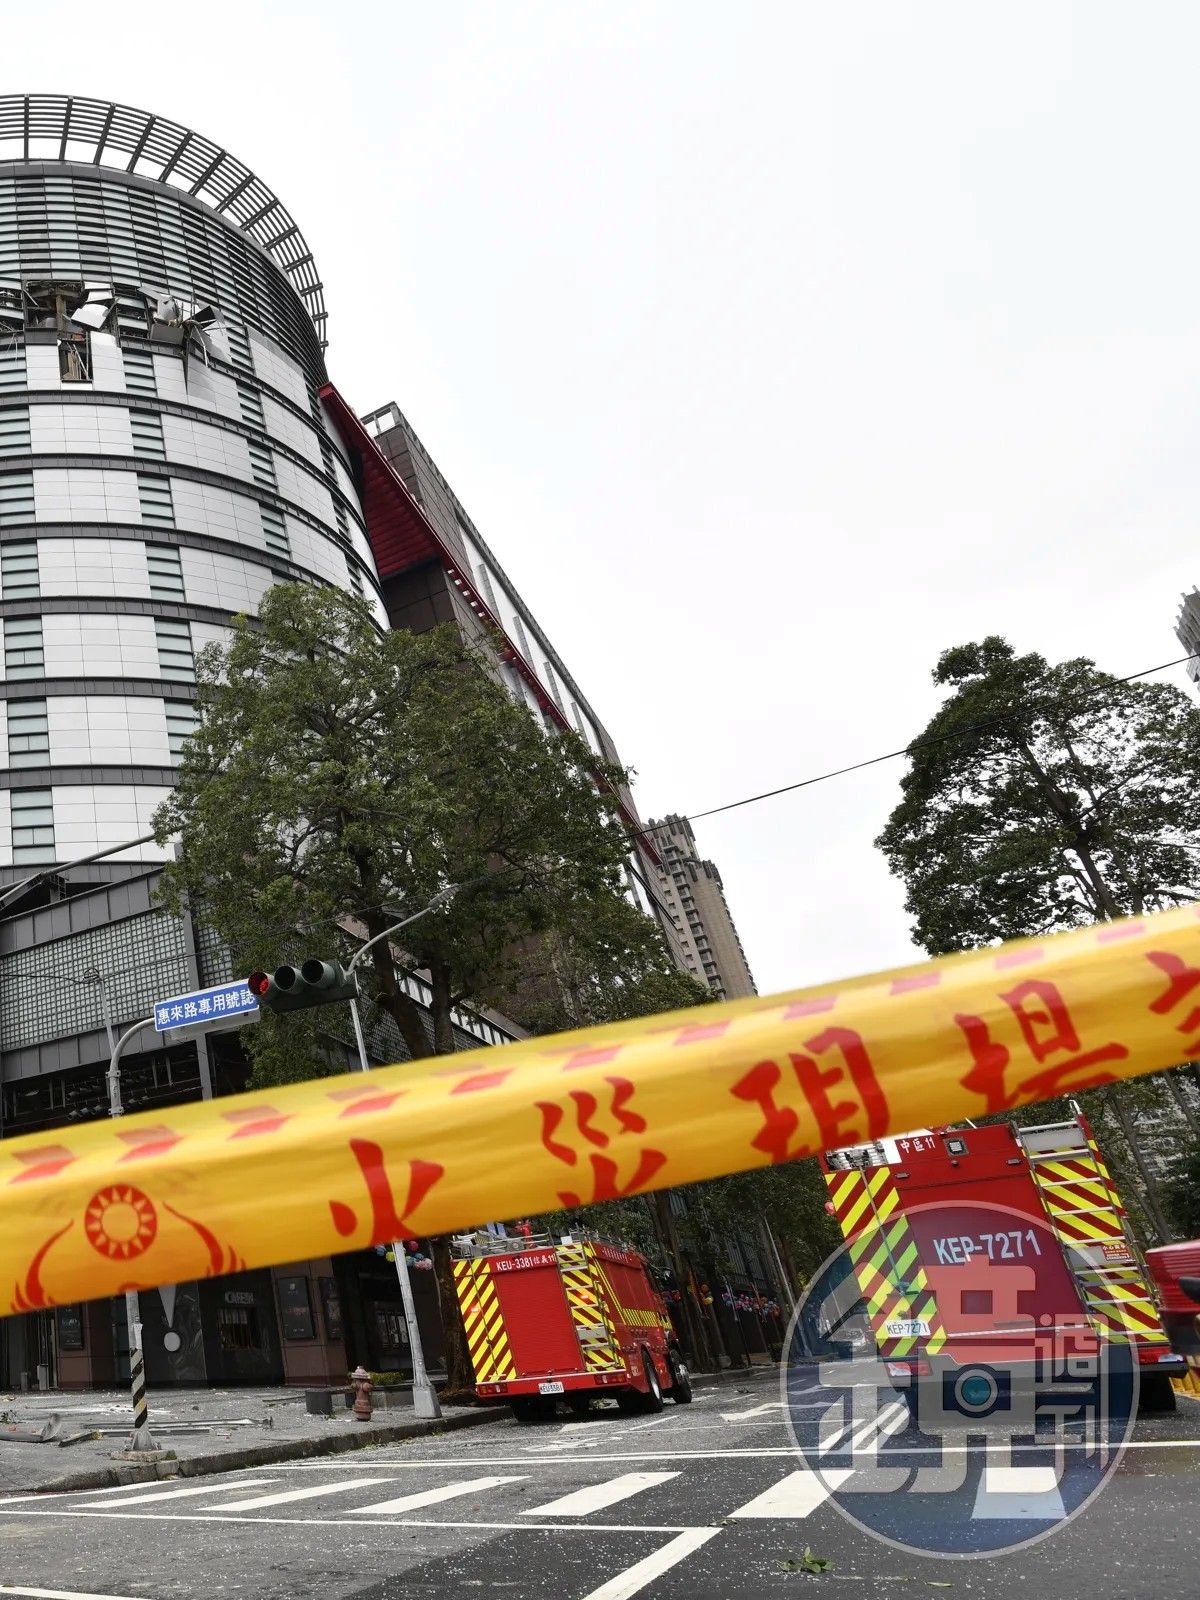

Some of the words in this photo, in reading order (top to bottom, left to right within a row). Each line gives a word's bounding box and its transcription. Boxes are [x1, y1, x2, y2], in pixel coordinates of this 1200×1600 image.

[157, 990, 255, 1024] 惠來路專用號誌
[900, 1137, 936, 1154] 中區11
[933, 1229, 1042, 1265] KEP-7271
[496, 1257, 534, 1271] KEU-3381
[886, 1321, 928, 1335] KEP-7271
